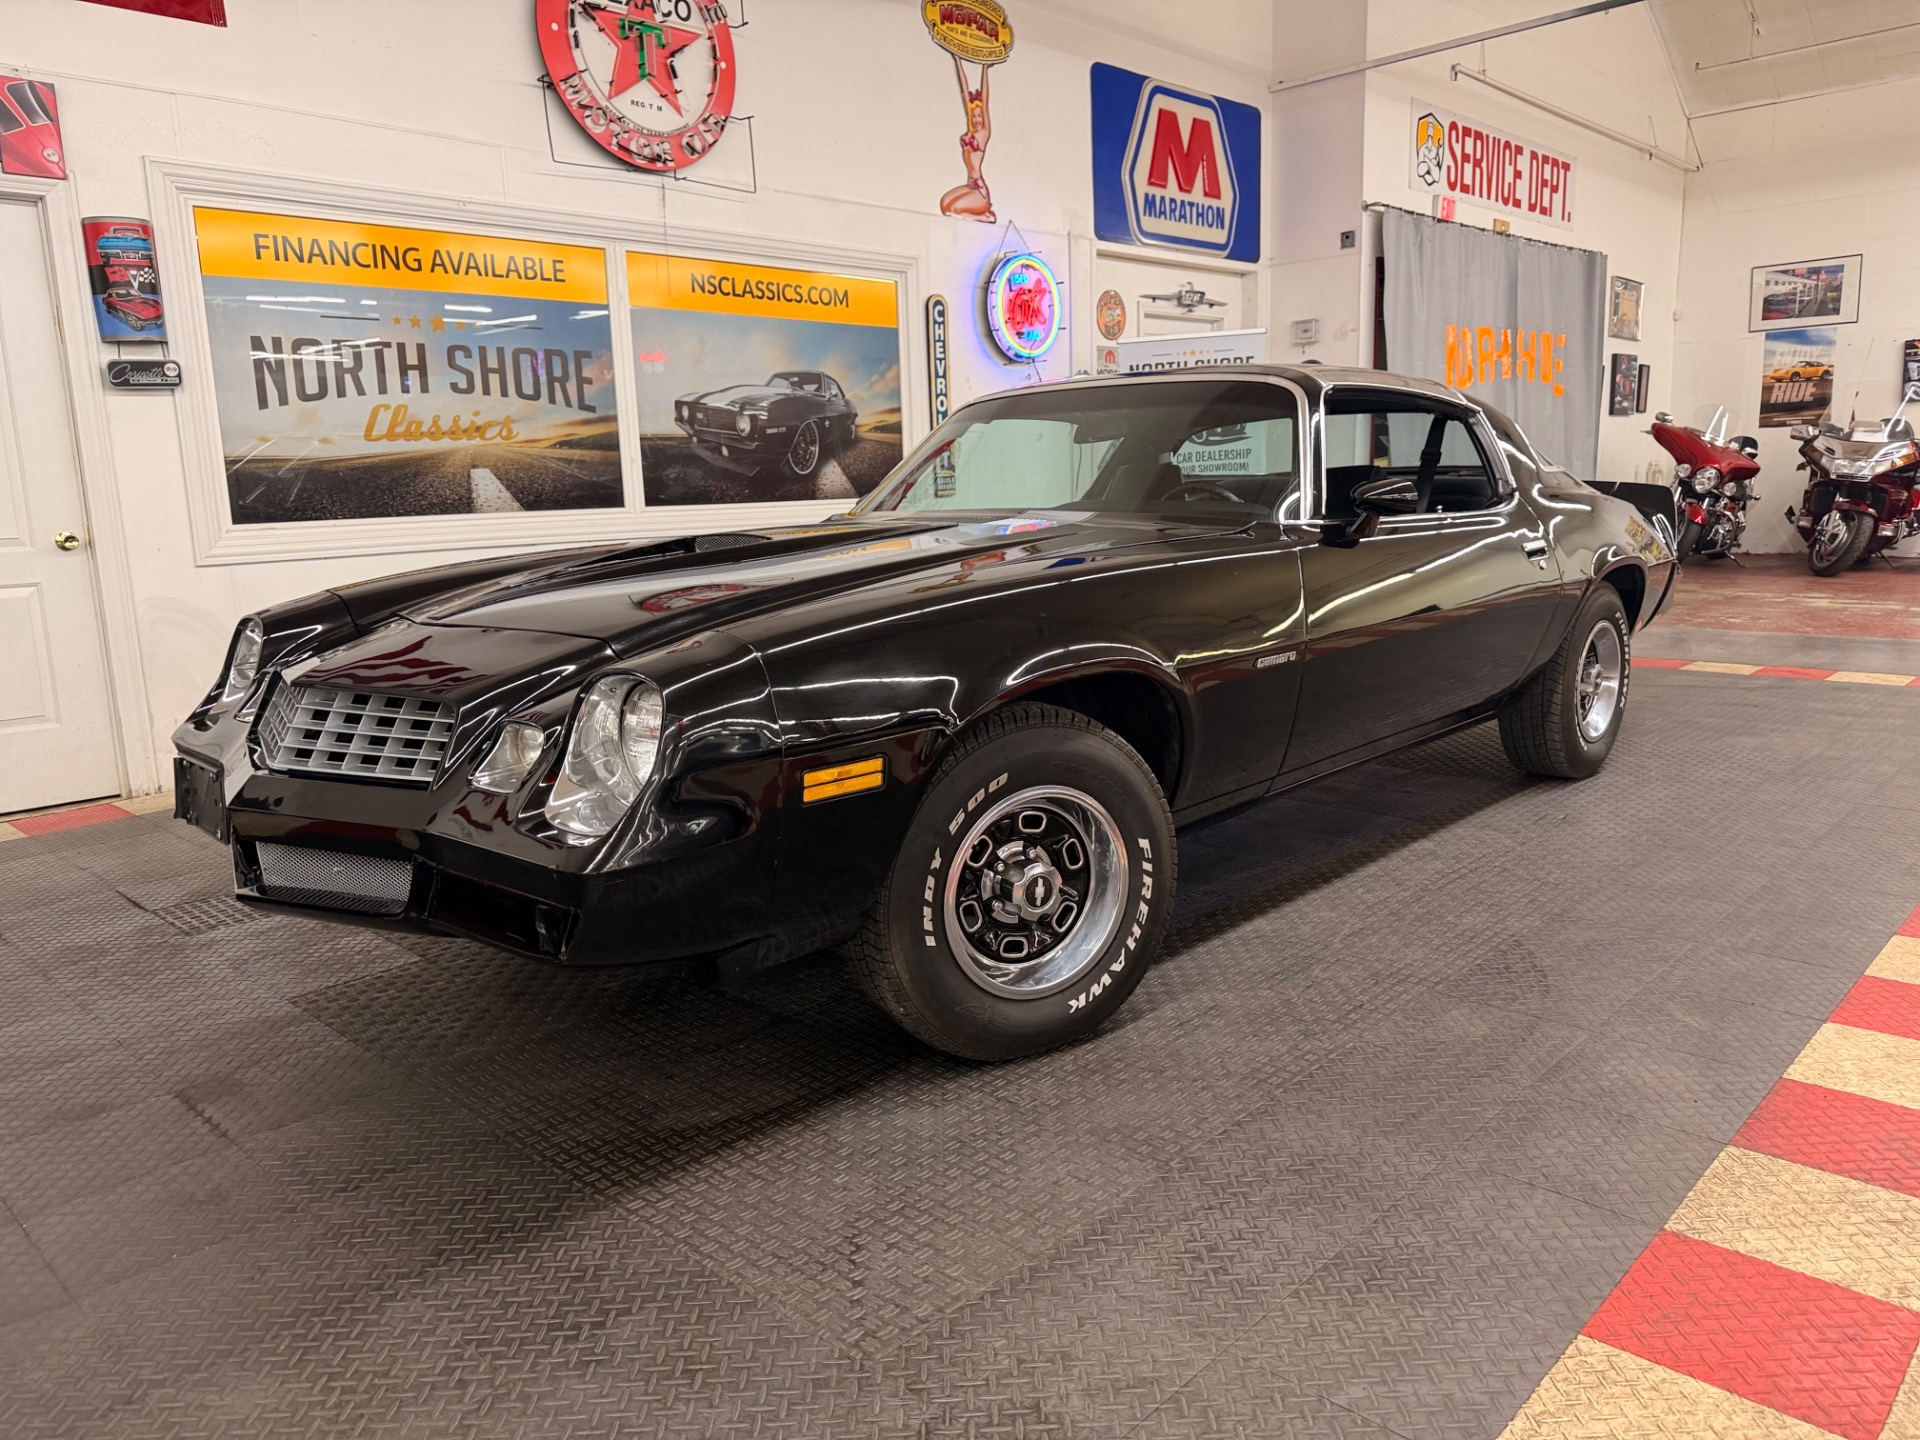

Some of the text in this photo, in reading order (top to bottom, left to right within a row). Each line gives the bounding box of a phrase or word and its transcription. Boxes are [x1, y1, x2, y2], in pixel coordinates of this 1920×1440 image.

[939, 4, 999, 43] MOPAR
[1446, 120, 1571, 223] SERVICE DEPT.
[1143, 193, 1226, 230] MARATHON
[253, 233, 567, 284] FINANCING AVAILABLE
[690, 272, 850, 308] NSCLASSICS.COM
[1104, 320, 1122, 338] BEE
[109, 363, 166, 383] Corvette
[250, 335, 598, 414] NORTH SHORE
[1769, 381, 1817, 404] RIDE
[363, 403, 520, 442] Classics
[1176, 448, 1252, 465] CAR DEALERSHIP
[1198, 462, 1250, 473] SHOWROOM!
[1614, 611, 1630, 710] FIREHAWK
[923, 772, 1009, 947] INDY 500
[1067, 837, 1153, 1014] FIREHAWK
